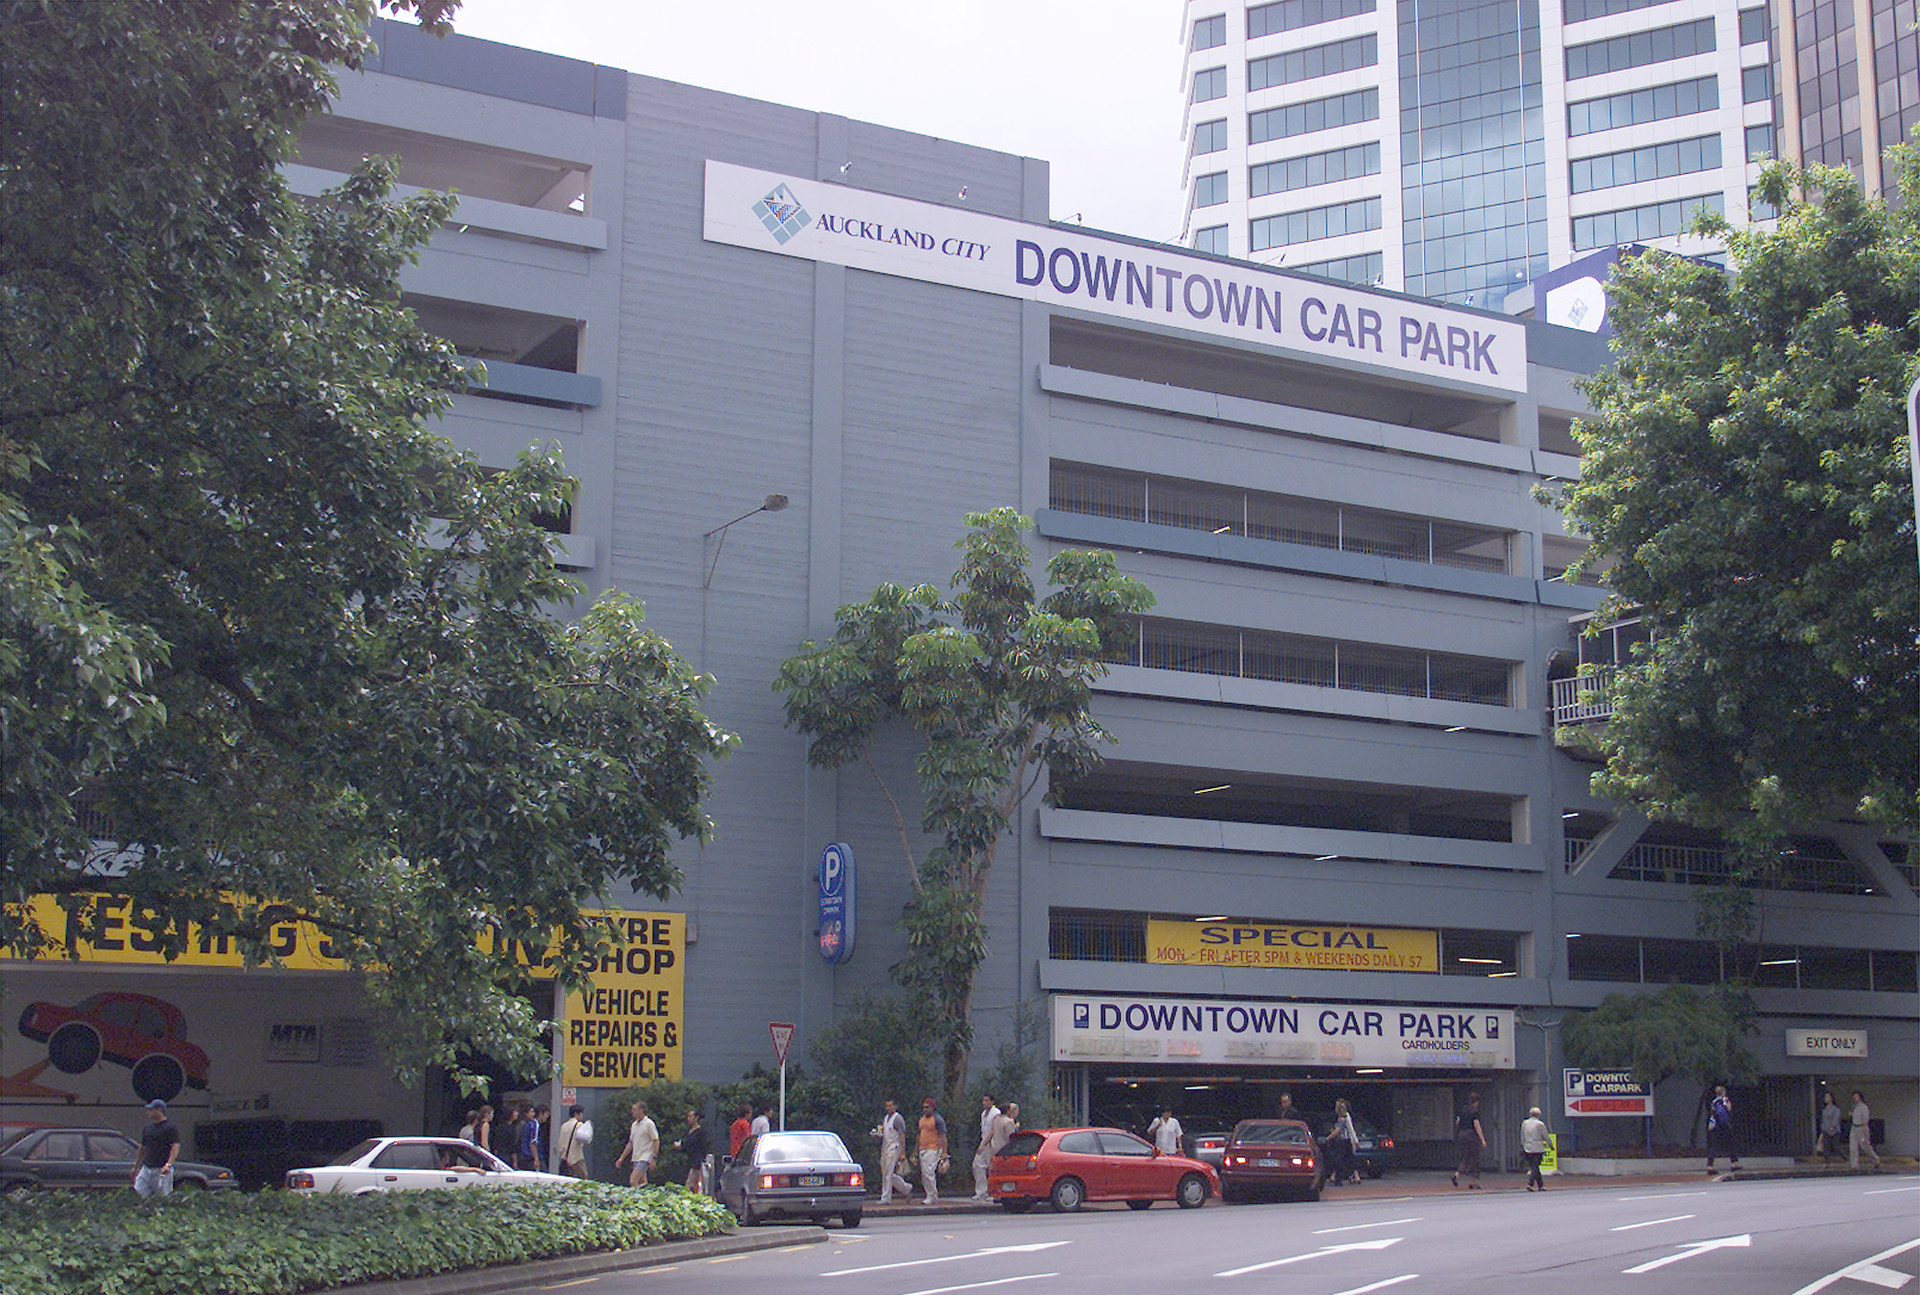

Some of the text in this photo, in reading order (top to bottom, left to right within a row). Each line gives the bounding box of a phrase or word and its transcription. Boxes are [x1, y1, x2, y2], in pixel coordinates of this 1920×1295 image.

[815, 213, 991, 262] AUCKLAND CITY
[1016, 239, 1498, 375] DOWNTOWN CAR PARK
[826, 851, 840, 890] P
[57, 896, 299, 957] TESG
[1200, 927, 1388, 950] SPECIAL
[578, 948, 675, 974] SHOP
[1157, 947, 1185, 961] MON
[1306, 952, 1369, 966] WEEKENDS
[1373, 954, 1405, 967] DAILY
[582, 988, 669, 1016] VEHICLE
[571, 1019, 677, 1048] REPAIRS &
[1100, 1003, 1299, 1033] DOWNTOWN
[1318, 1010, 1383, 1036] CAR
[1400, 1013, 1477, 1039] PARK
[1402, 1040, 1470, 1050] CARDHOLDERS
[1806, 1037, 1856, 1048] EXIT ONLY
[580, 1051, 666, 1078] SERVICE
[1586, 1073, 1630, 1082] DOWNTO
[1593, 1083, 1642, 1093] CARPARK
